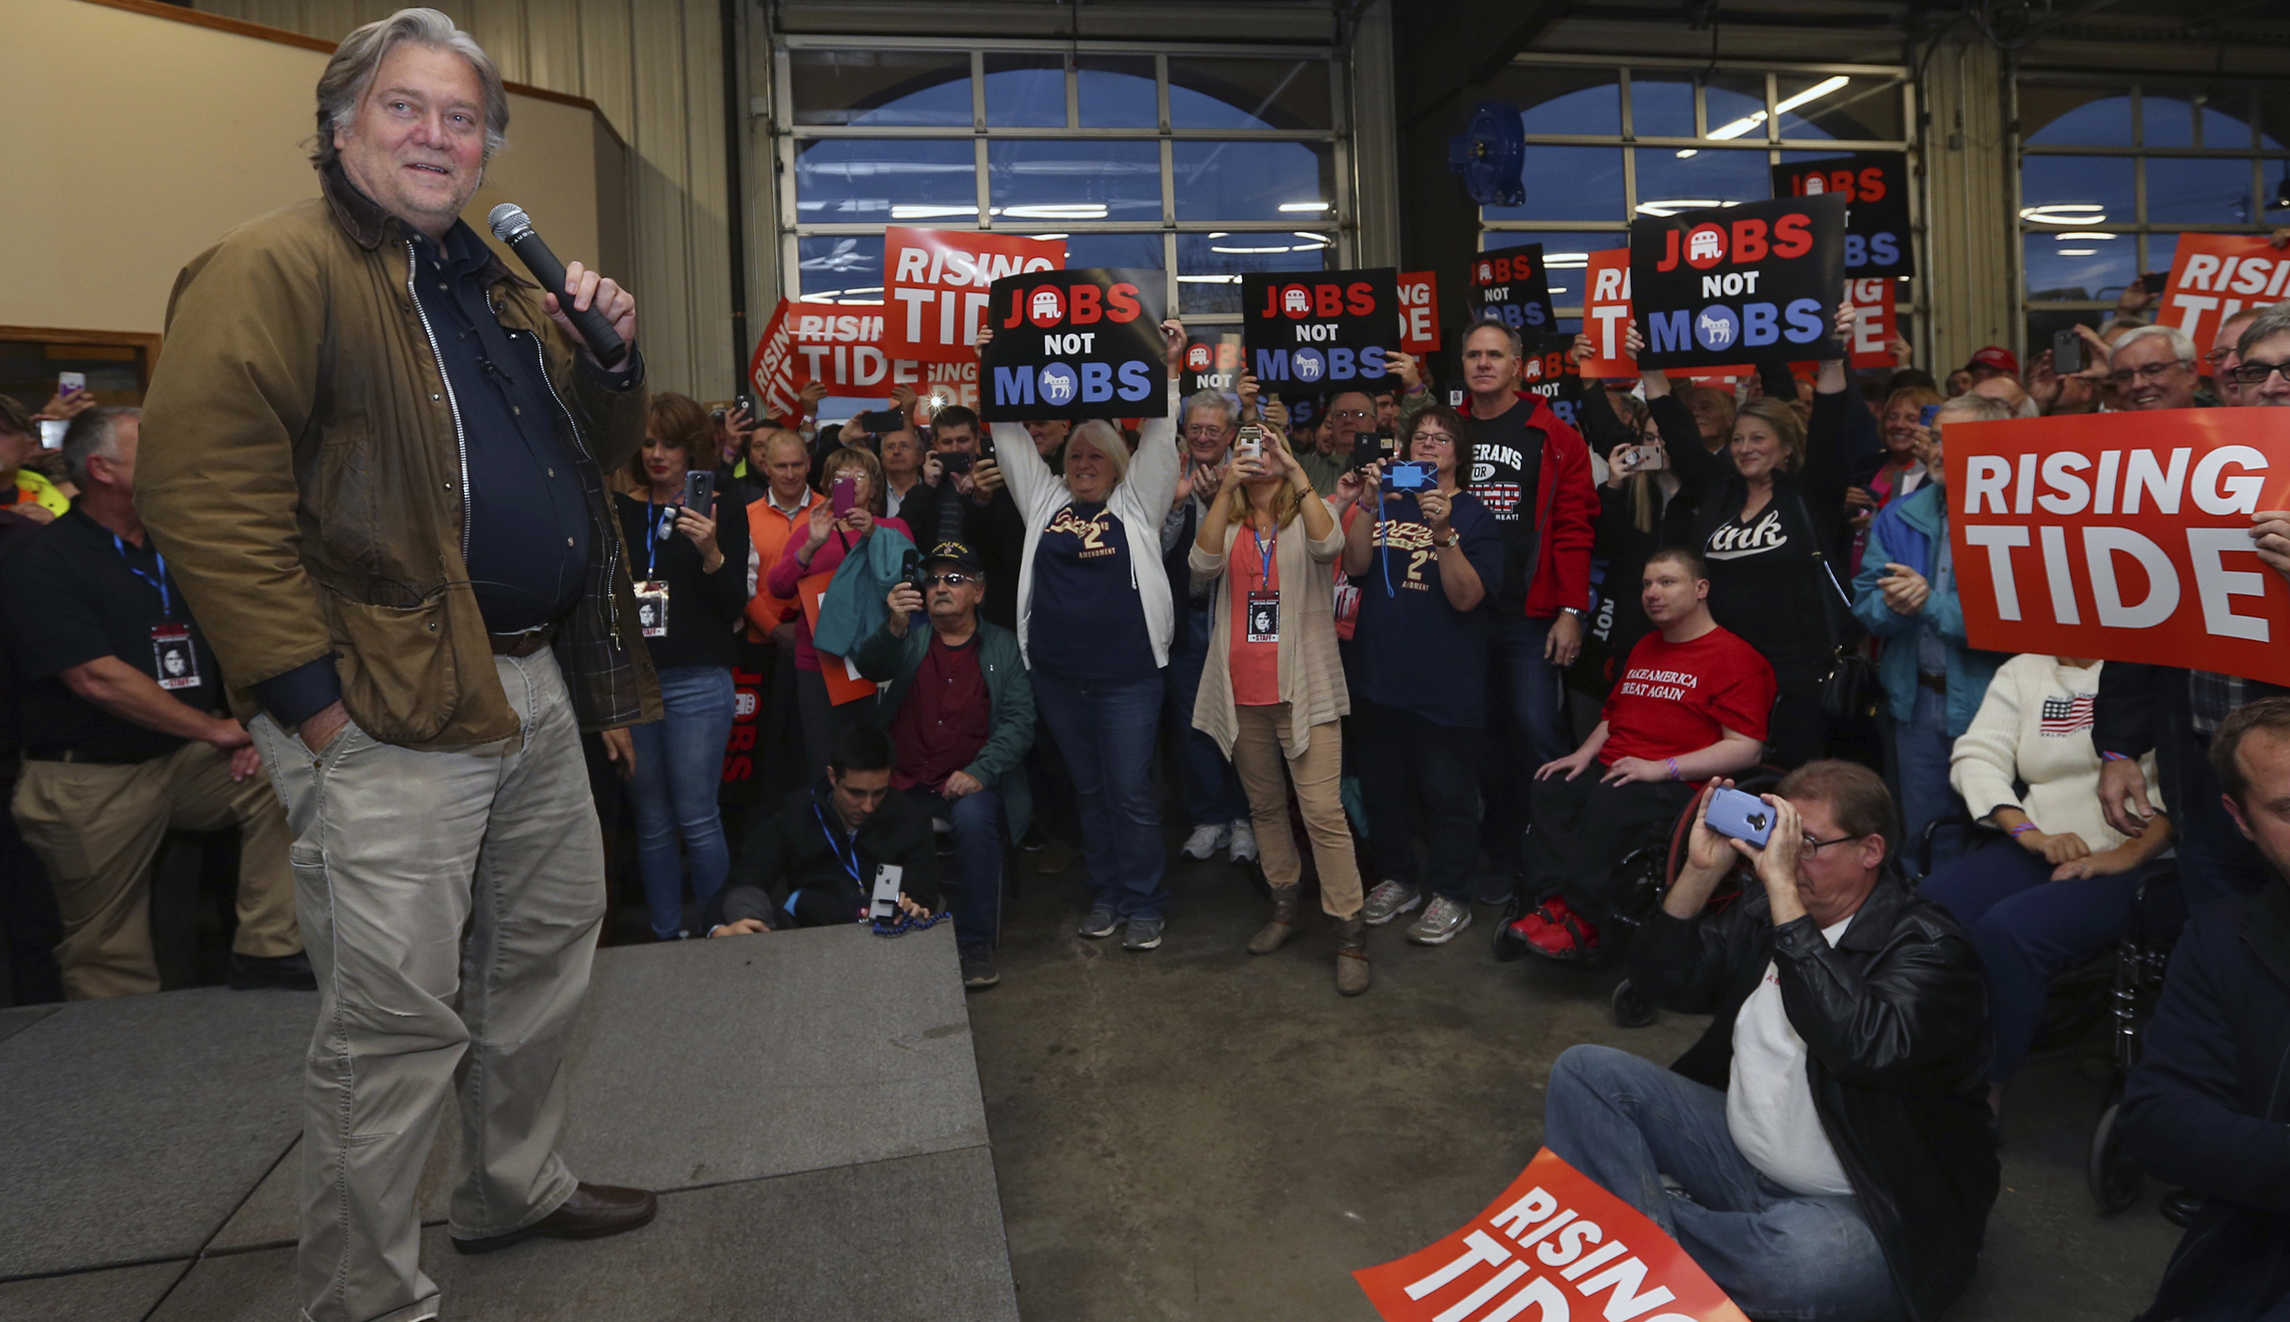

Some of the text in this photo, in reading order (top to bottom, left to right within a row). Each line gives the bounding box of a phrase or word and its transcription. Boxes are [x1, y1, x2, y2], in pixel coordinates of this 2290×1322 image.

[1656, 213, 1814, 272] JOBS
[1845, 232, 1901, 267] BS
[1471, 255, 1532, 286] JOBS
[1702, 271, 1760, 299] NOT
[2178, 253, 2290, 297] RISI
[1003, 282, 1142, 329] JOBS
[1261, 282, 1376, 320] JOBS
[1484, 287, 1510, 302] NOT
[1475, 302, 1546, 328] OBS
[1648, 298, 1824, 353] MOBS
[1044, 332, 1096, 356] NOT
[1295, 323, 1339, 342] NOT
[798, 345, 919, 387] TIDE
[1256, 345, 1387, 383] MOBS
[1521, 349, 1580, 383] OBS
[993, 360, 1152, 407] MOBS
[1196, 374, 1232, 389] NOT
[1531, 382, 1561, 398] NOT
[1472, 443, 1523, 471] ERANS
[1474, 466, 1487, 478] OR
[1964, 445, 2270, 515] RISING
[1078, 547, 1116, 559] AMENDMENT
[1965, 525, 2270, 643] TIDE
[643, 628, 657, 636] TAFF
[1592, 598, 1615, 642] NOT
[1646, 669, 1698, 689] AMERICA
[1646, 685, 1686, 701] AGAIN
[722, 666, 763, 782] JOBS
[1489, 1186, 1700, 1322] RISIN
